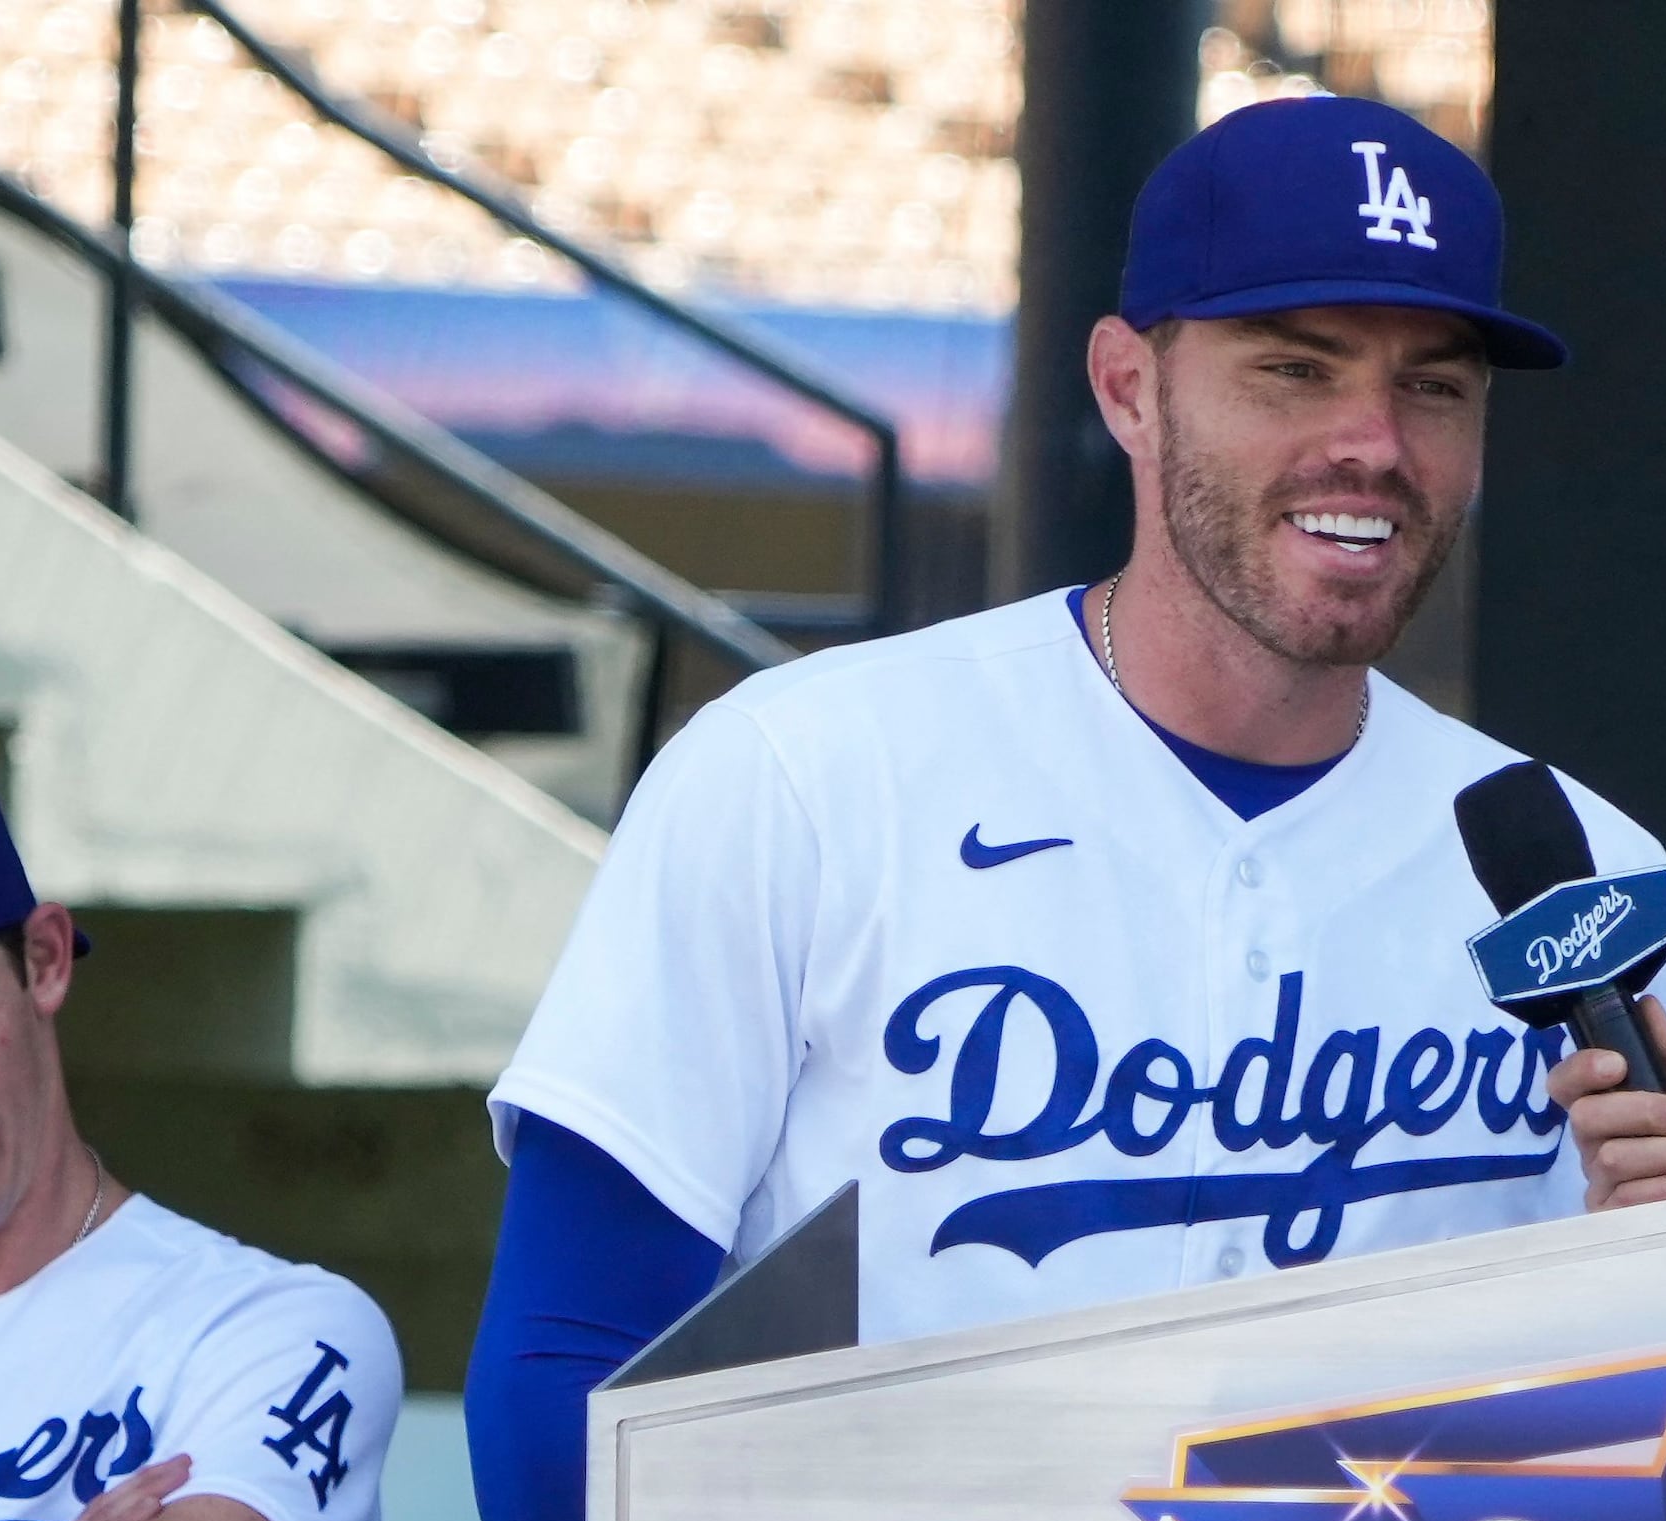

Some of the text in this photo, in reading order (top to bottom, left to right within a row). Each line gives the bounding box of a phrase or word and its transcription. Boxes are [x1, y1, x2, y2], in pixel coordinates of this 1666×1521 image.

[1351, 142, 1437, 250] LA
[1526, 885, 1633, 985] Dodgers
[879, 965, 1569, 1270] Dodgers
[262, 1339, 354, 1512] LA
